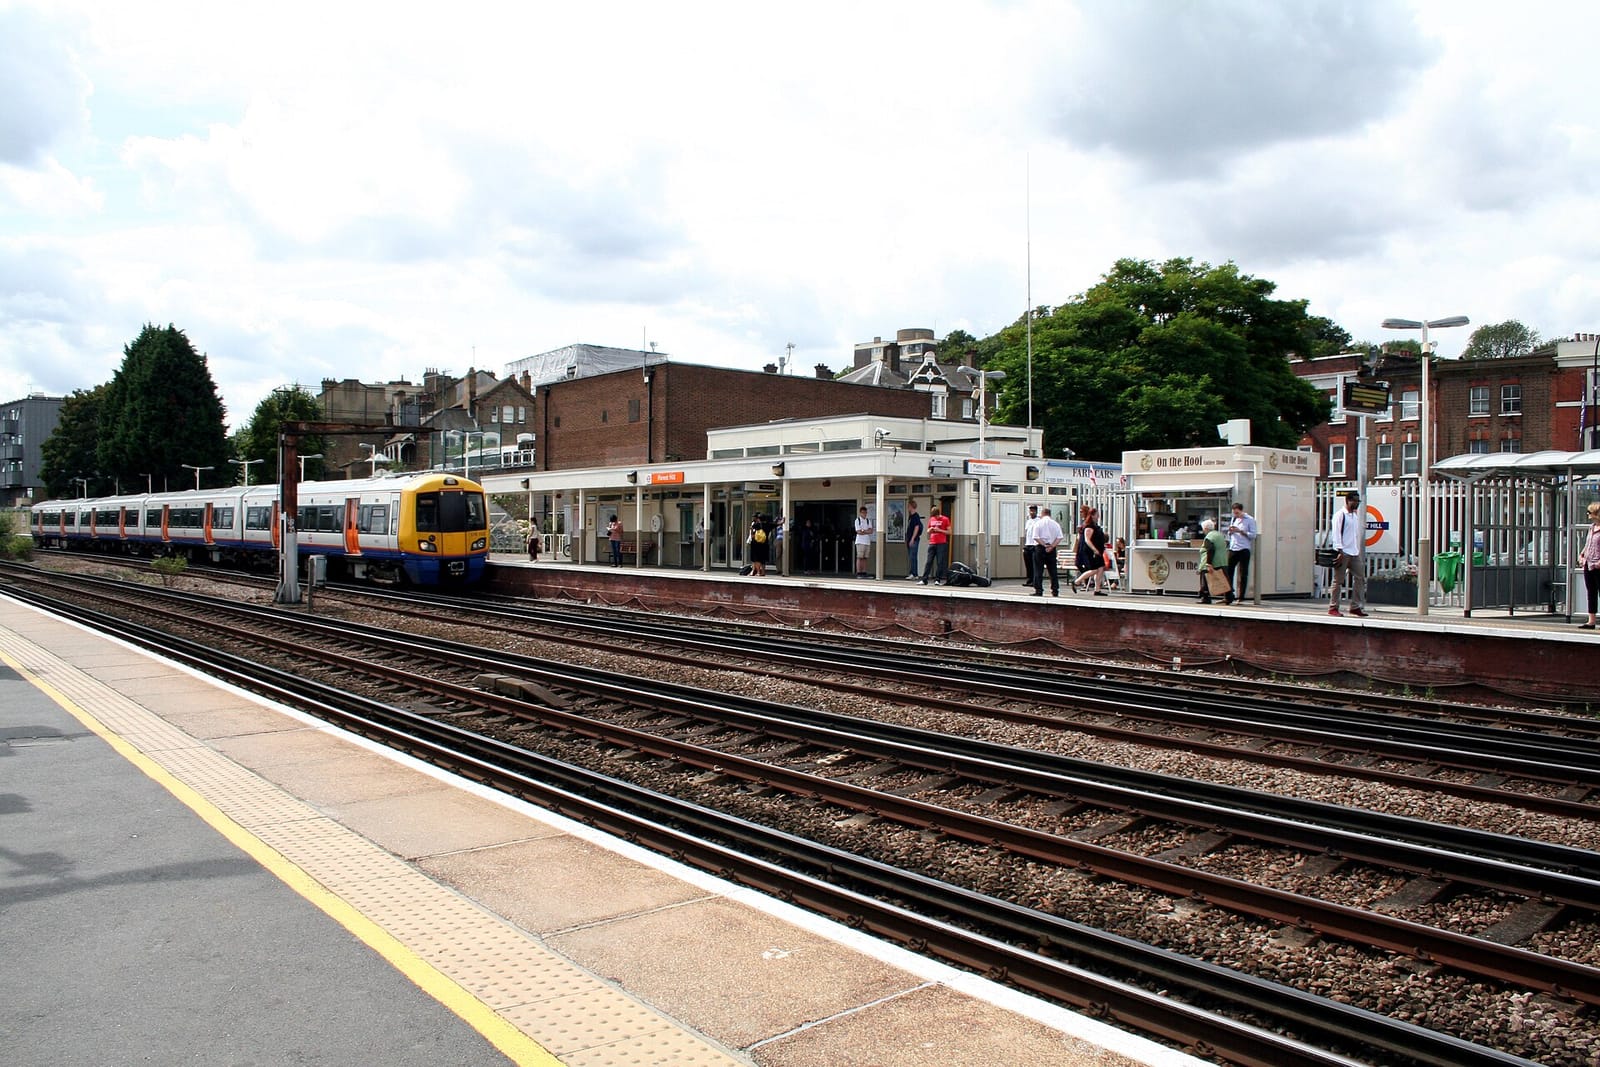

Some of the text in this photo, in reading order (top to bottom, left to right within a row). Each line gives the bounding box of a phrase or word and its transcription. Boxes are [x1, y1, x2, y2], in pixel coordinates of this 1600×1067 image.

[1157, 456, 1167, 467] On
[1169, 456, 1182, 467] the
[1094, 469, 1114, 479] CARS
[1175, 561, 1199, 570] On the
